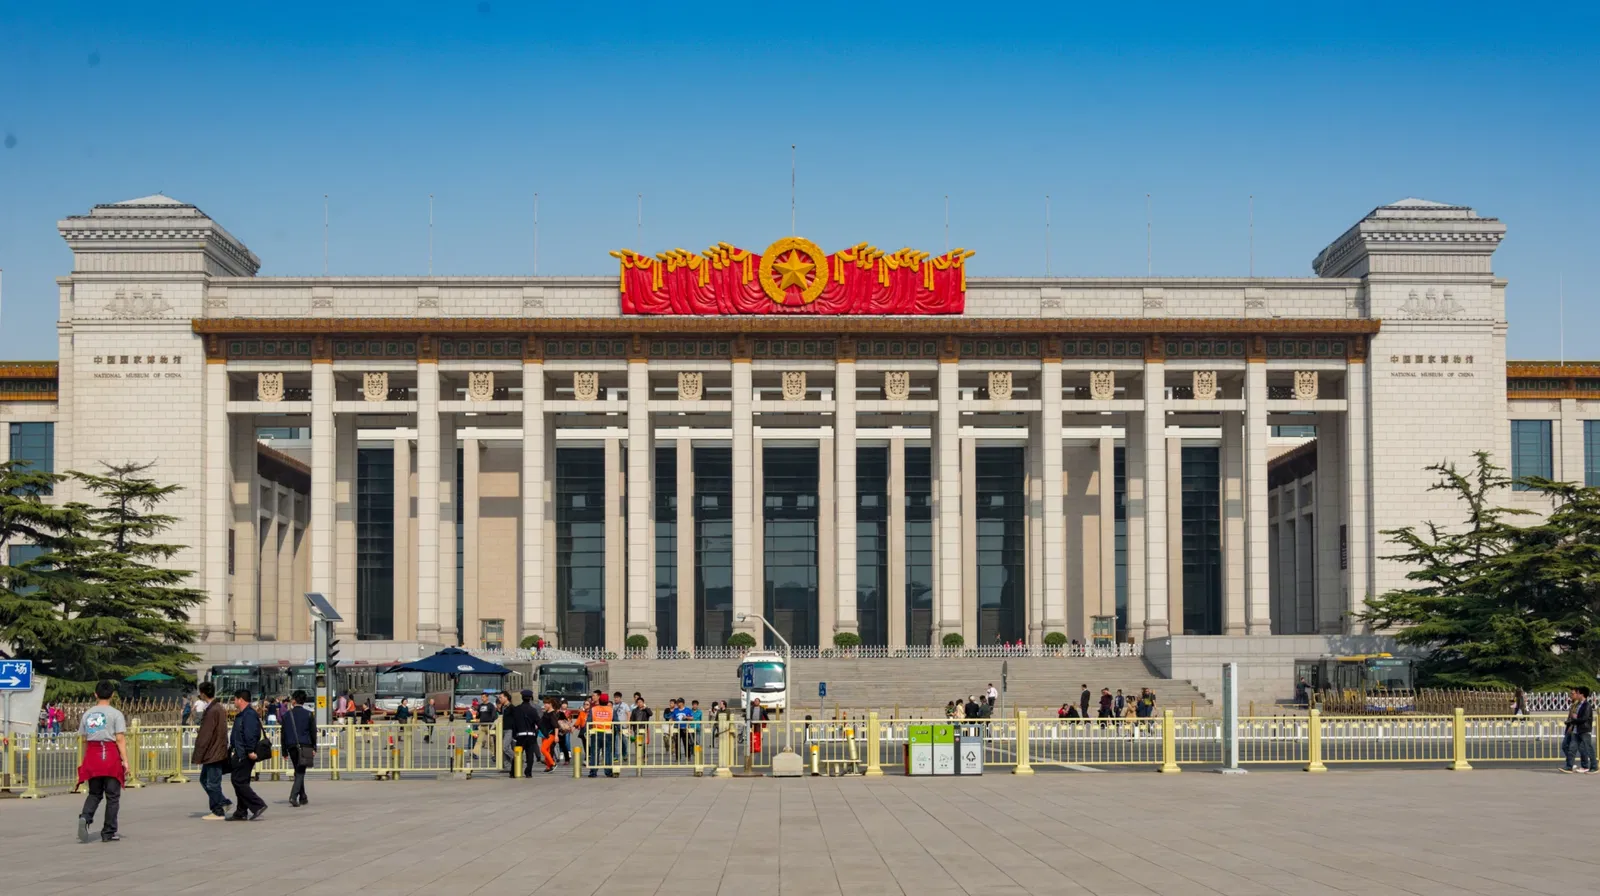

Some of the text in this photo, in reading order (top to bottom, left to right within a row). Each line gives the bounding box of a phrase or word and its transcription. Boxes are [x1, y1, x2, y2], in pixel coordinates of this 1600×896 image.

[93, 355, 182, 364] 中国国家博物馆
[1390, 355, 1473, 364] 中国国家博物馆
[2, 663, 27, 674] 广场
